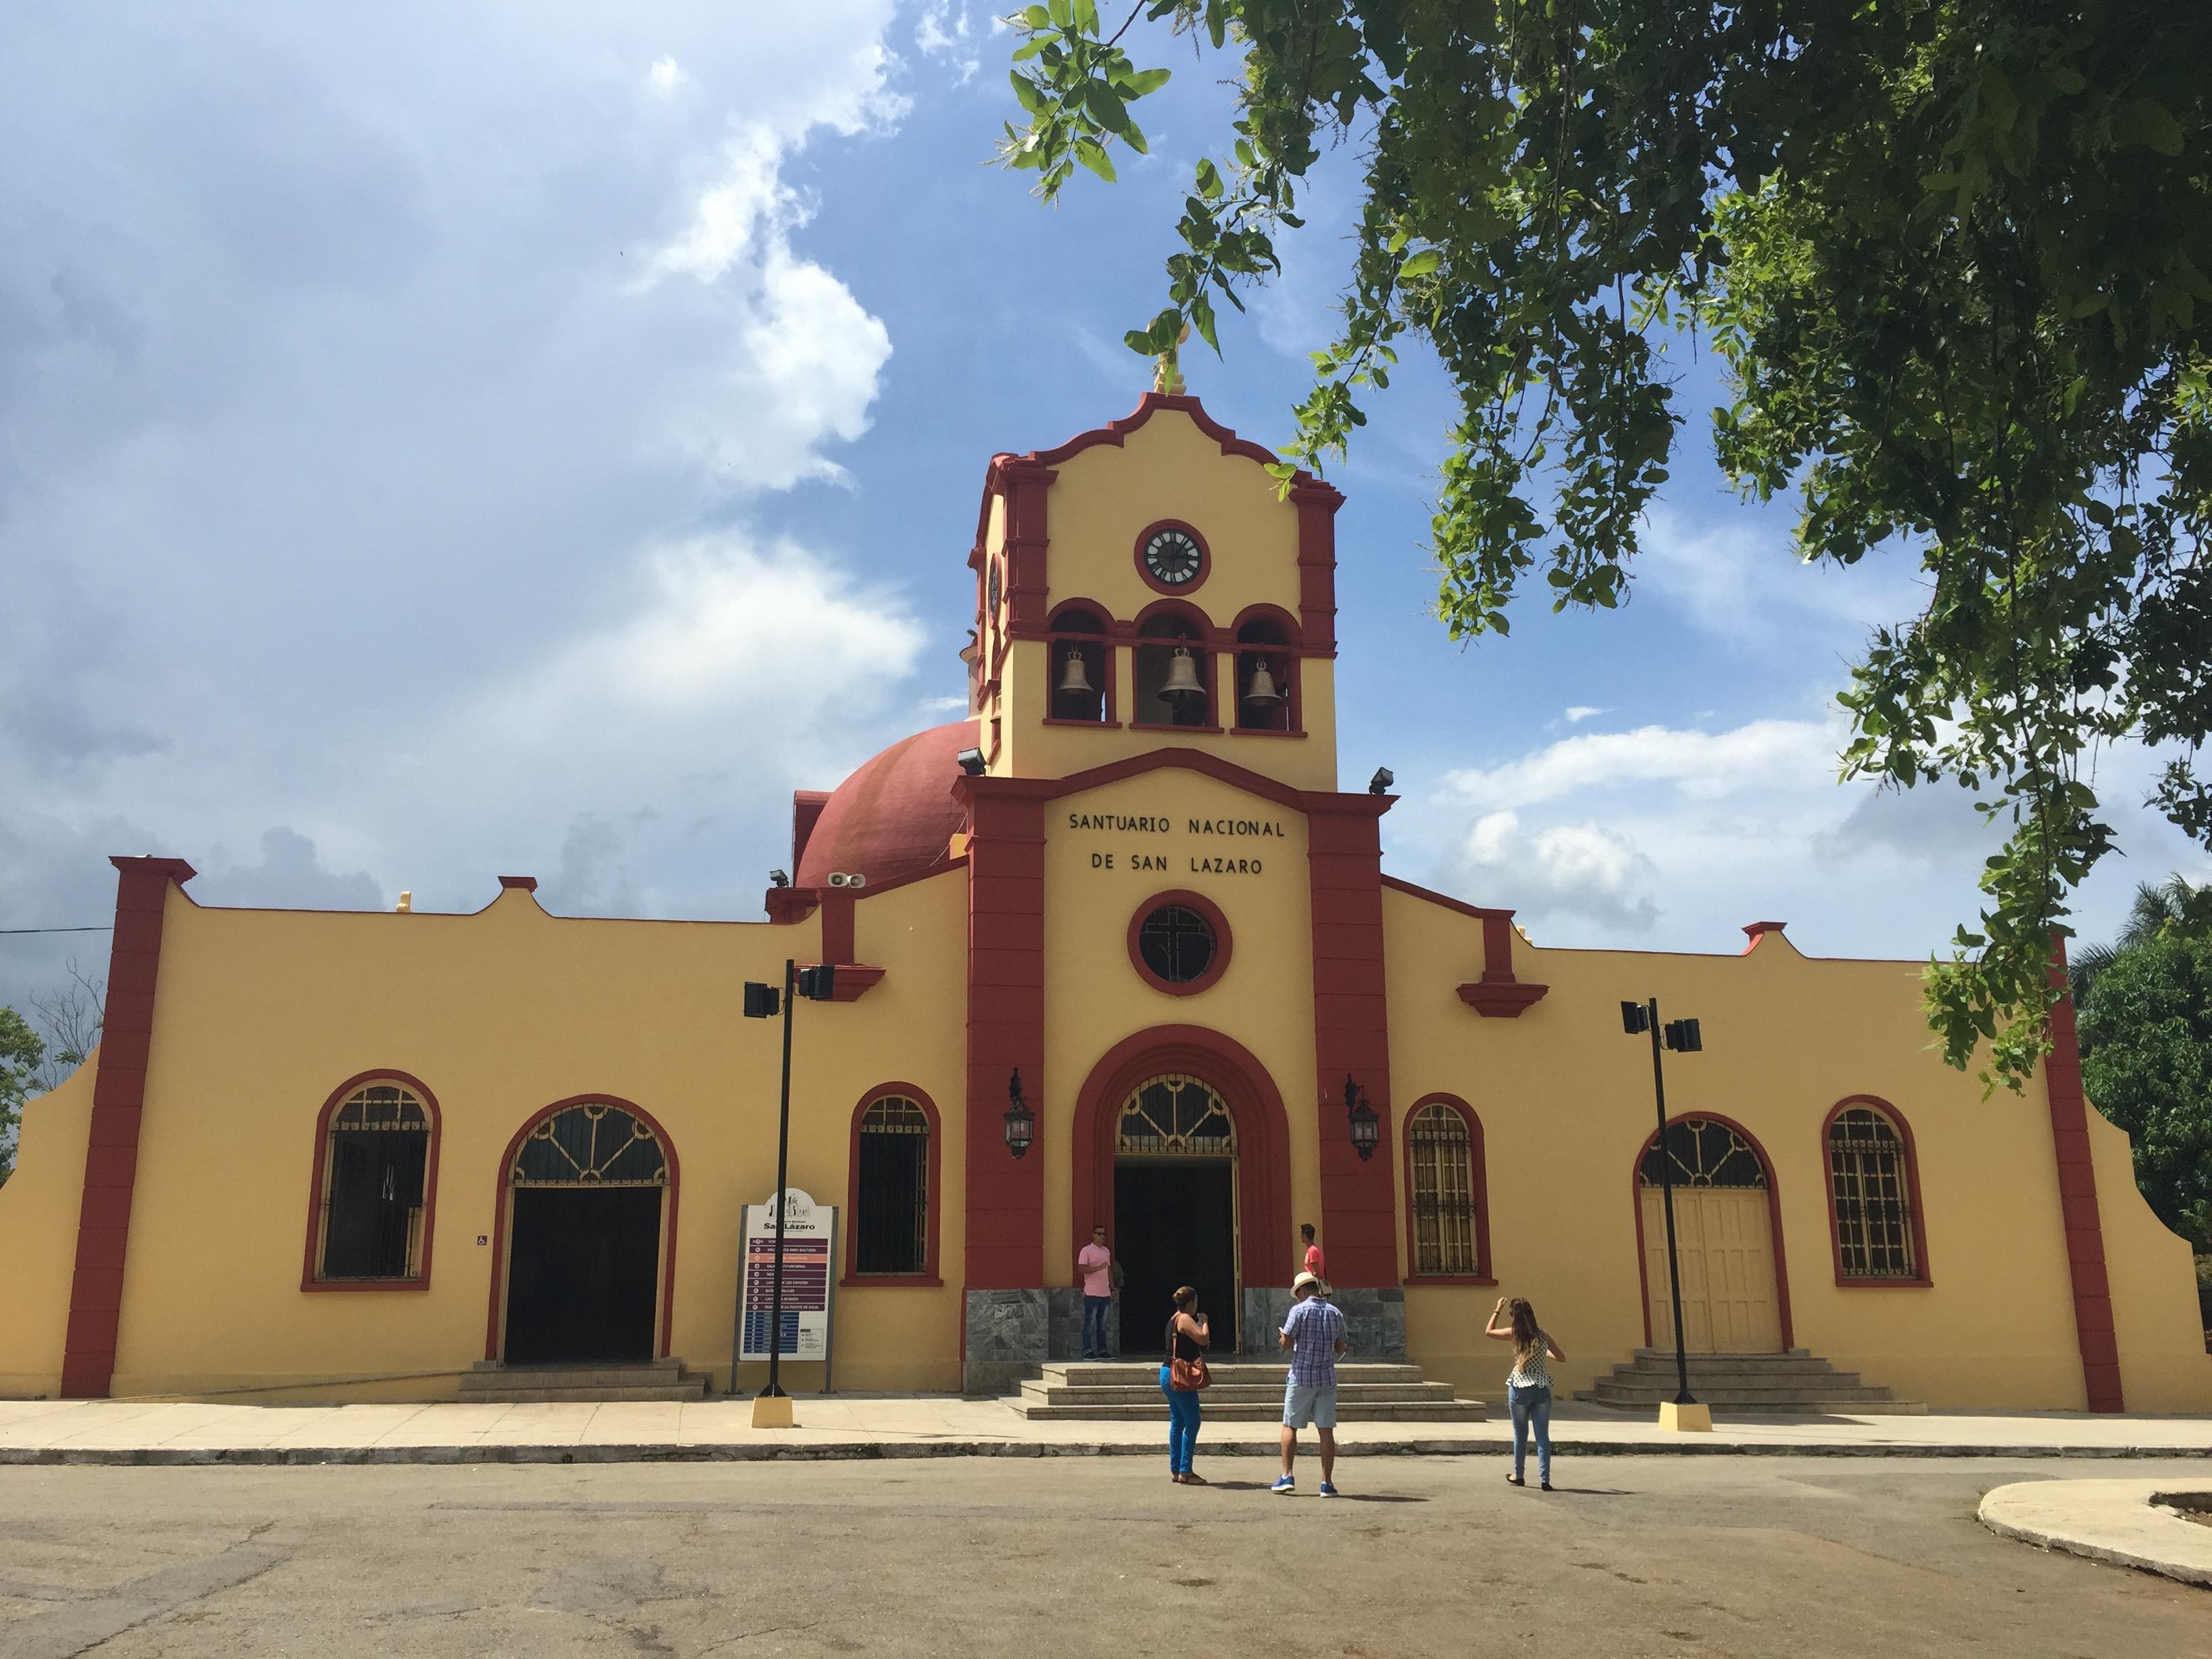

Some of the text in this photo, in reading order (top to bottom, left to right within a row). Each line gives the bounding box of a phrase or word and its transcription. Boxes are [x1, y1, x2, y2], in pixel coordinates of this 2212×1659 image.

[1069, 813, 1285, 837] SANTUARIO NACIONAL
[1092, 853, 1262, 874] DE SAN LAZARO
